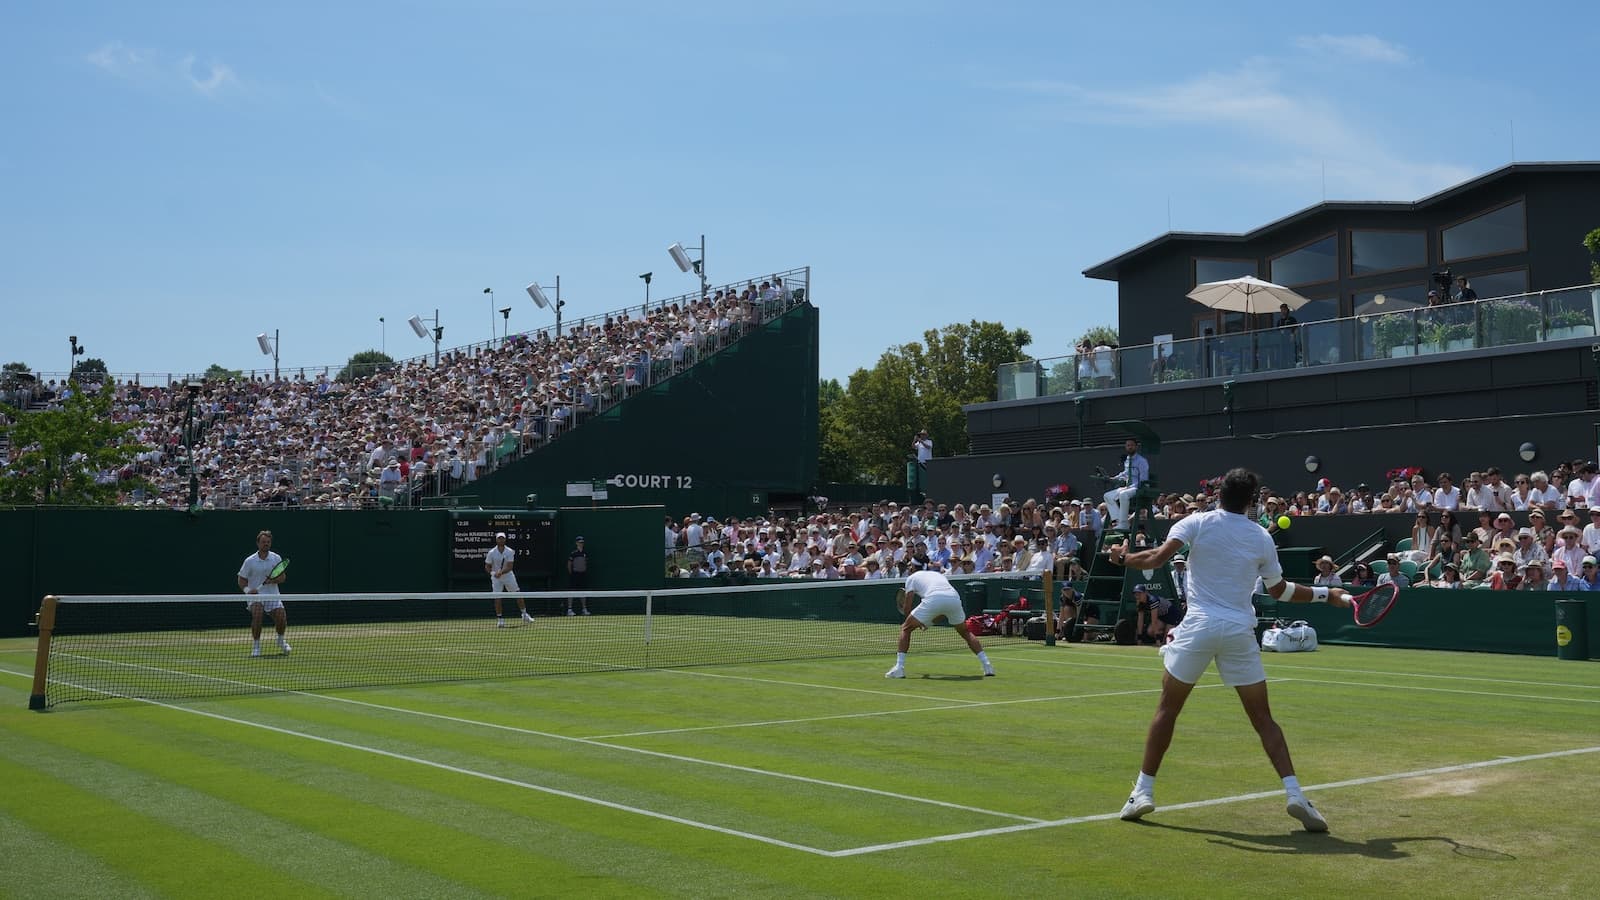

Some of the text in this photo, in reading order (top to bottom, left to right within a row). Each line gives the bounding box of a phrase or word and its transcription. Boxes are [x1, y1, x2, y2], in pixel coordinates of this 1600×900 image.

[615, 474, 671, 489] COURT
[676, 476, 692, 489] 12
[752, 496, 760, 504] 12
